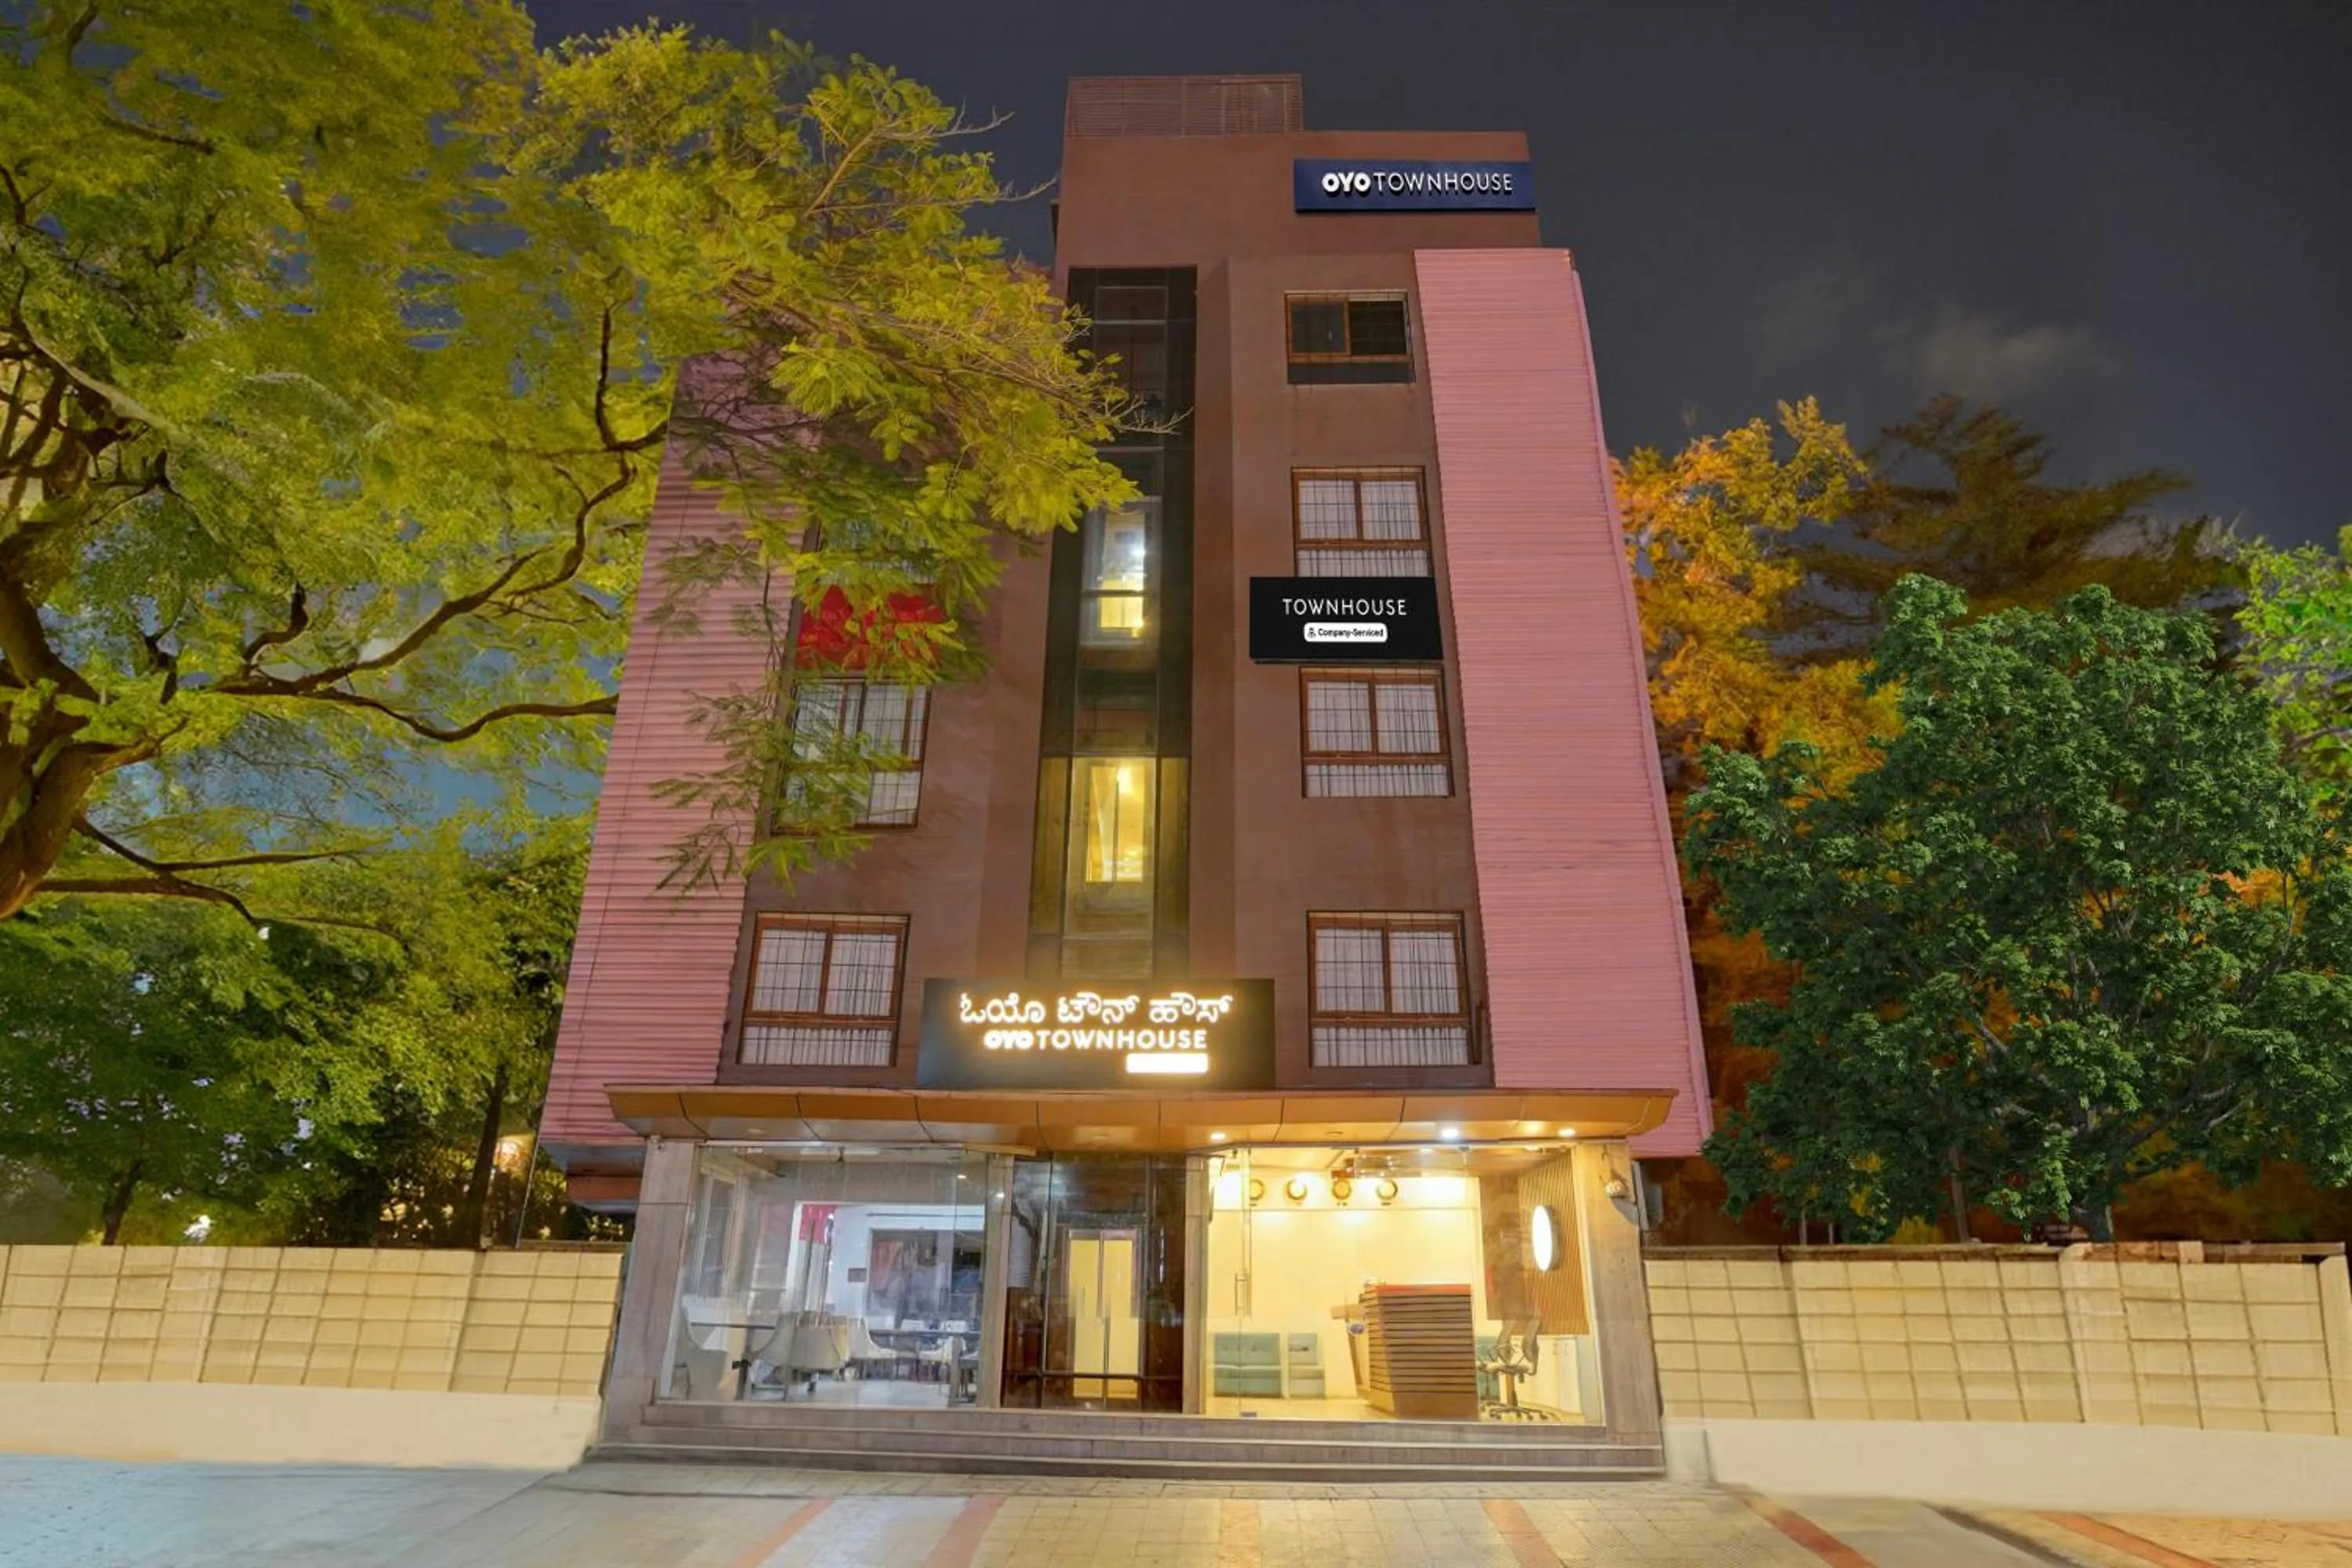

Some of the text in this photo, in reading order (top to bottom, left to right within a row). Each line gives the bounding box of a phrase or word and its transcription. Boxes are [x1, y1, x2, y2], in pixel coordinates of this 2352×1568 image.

[1322, 172, 1512, 192] OYO TOWNHOUSE
[1282, 598, 1407, 616] TOWNHOUSE
[1318, 628, 1384, 638] Company-Serviced
[1057, 991, 1140, 1025] ಟೌನ್
[1149, 992, 1234, 1024] ಹೌಸ್
[984, 1029, 1208, 1050] OYO TOWNHOUSE
